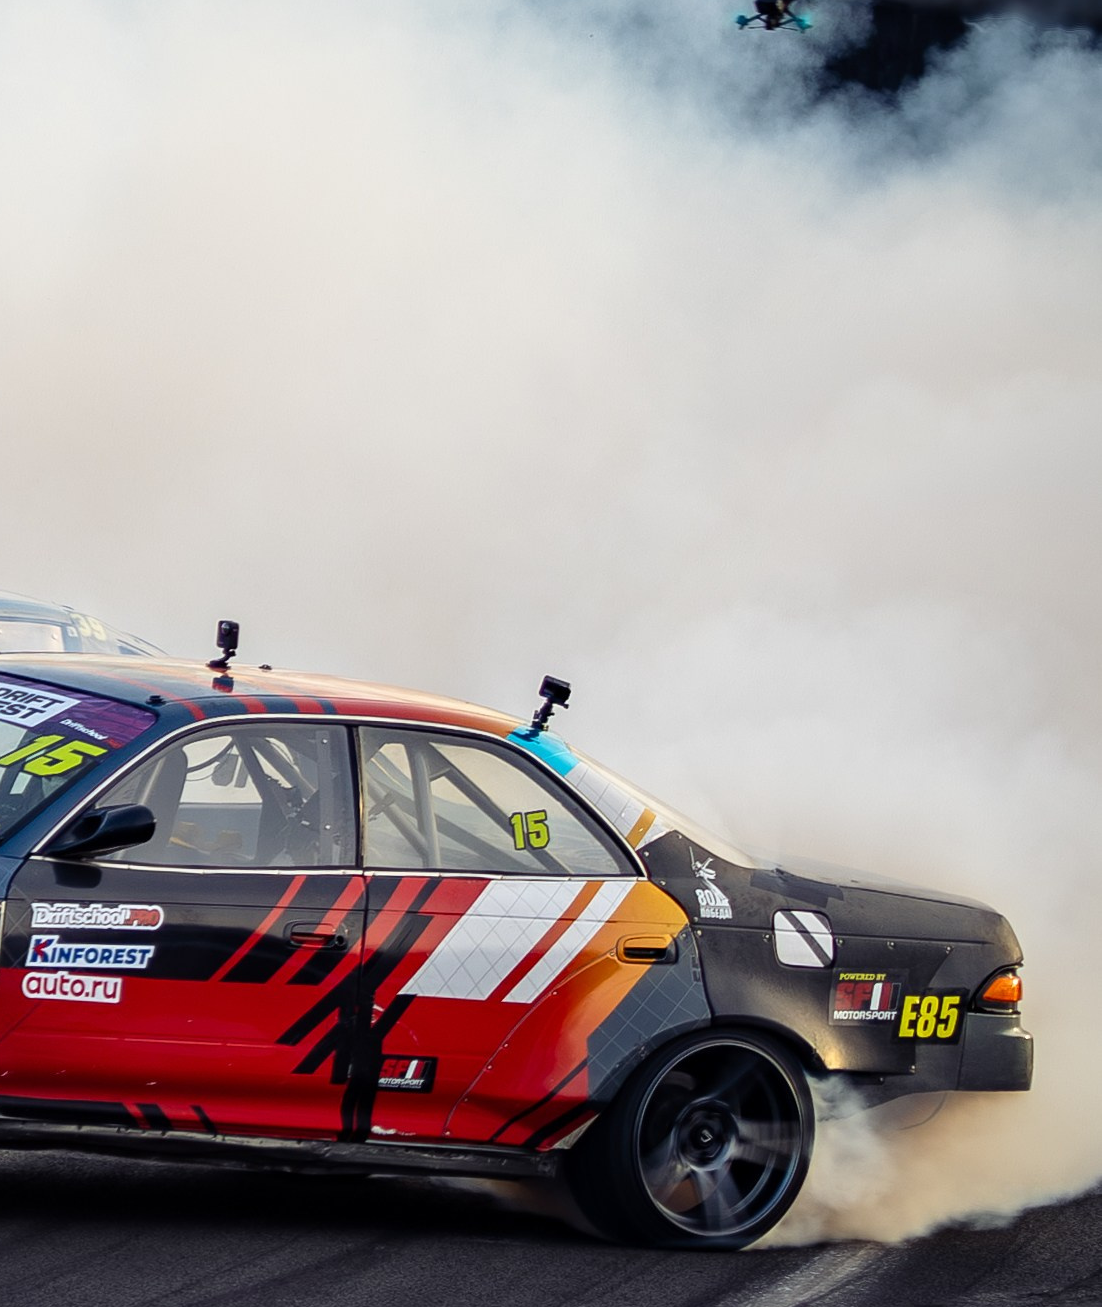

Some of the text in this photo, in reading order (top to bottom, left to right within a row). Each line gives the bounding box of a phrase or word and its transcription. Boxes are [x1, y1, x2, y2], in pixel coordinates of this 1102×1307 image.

[509, 809, 549, 849] 15
[695, 888, 716, 906] 80
[25, 973, 118, 999] auto.ru
[839, 973, 887, 981] POWERED BY
[833, 1010, 897, 1020] MOTORSPORT
[899, 995, 960, 1038] E85
